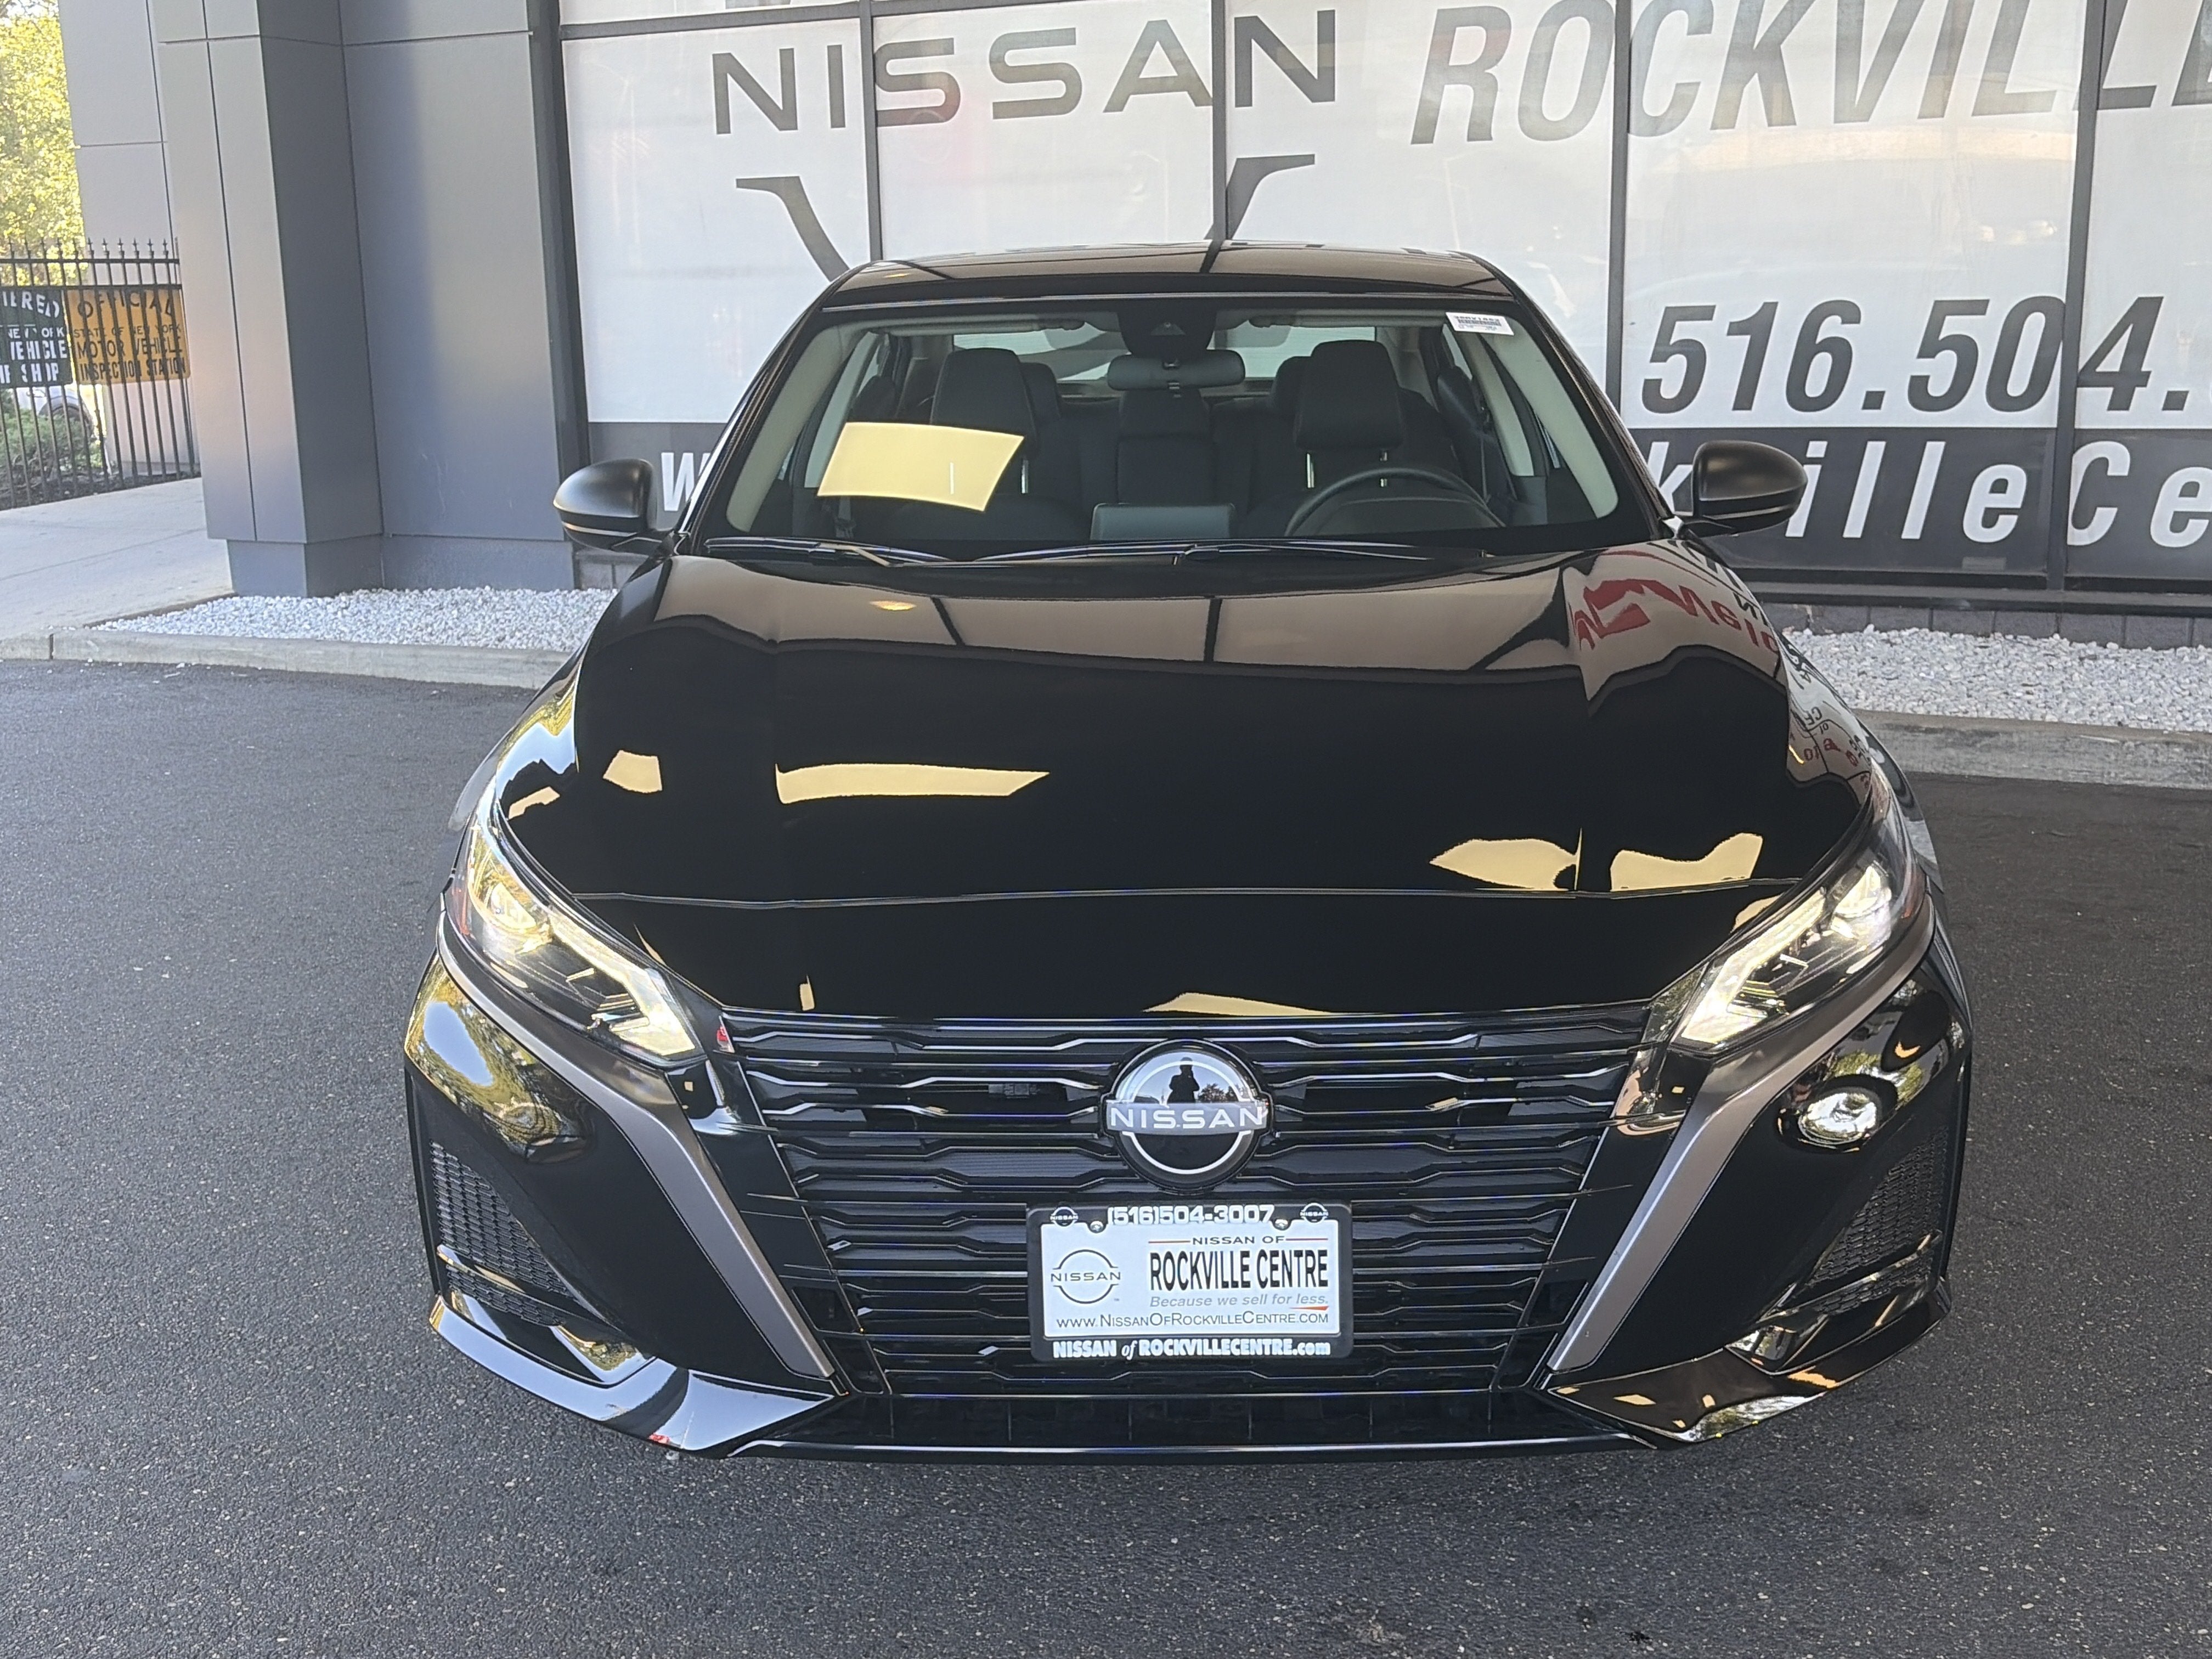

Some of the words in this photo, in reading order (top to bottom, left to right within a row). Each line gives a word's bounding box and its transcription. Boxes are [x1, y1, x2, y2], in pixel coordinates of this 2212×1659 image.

[712, 9, 1335, 135] NISSAN
[1110, 1107, 1263, 1129] NISSAN
[1108, 1205, 1274, 1225] (516)504-3007
[1193, 1236, 1255, 1245] NISSAN
[1262, 1235, 1285, 1244] OF
[1051, 1272, 1121, 1282] NISSAN
[1150, 1250, 1251, 1290] ROCKVILLE
[1256, 1249, 1328, 1289] CENTRE
[1150, 1295, 1212, 1307] Because
[1217, 1297, 1237, 1305] we
[1242, 1294, 1267, 1305] sell
[1272, 1294, 1292, 1305] for
[1296, 1293, 1328, 1304] less.
[1053, 1340, 1117, 1358] NISSAN
[1121, 1340, 1137, 1360] of
[1139, 1339, 1330, 1356] ROCKVILLECENTRE.com
